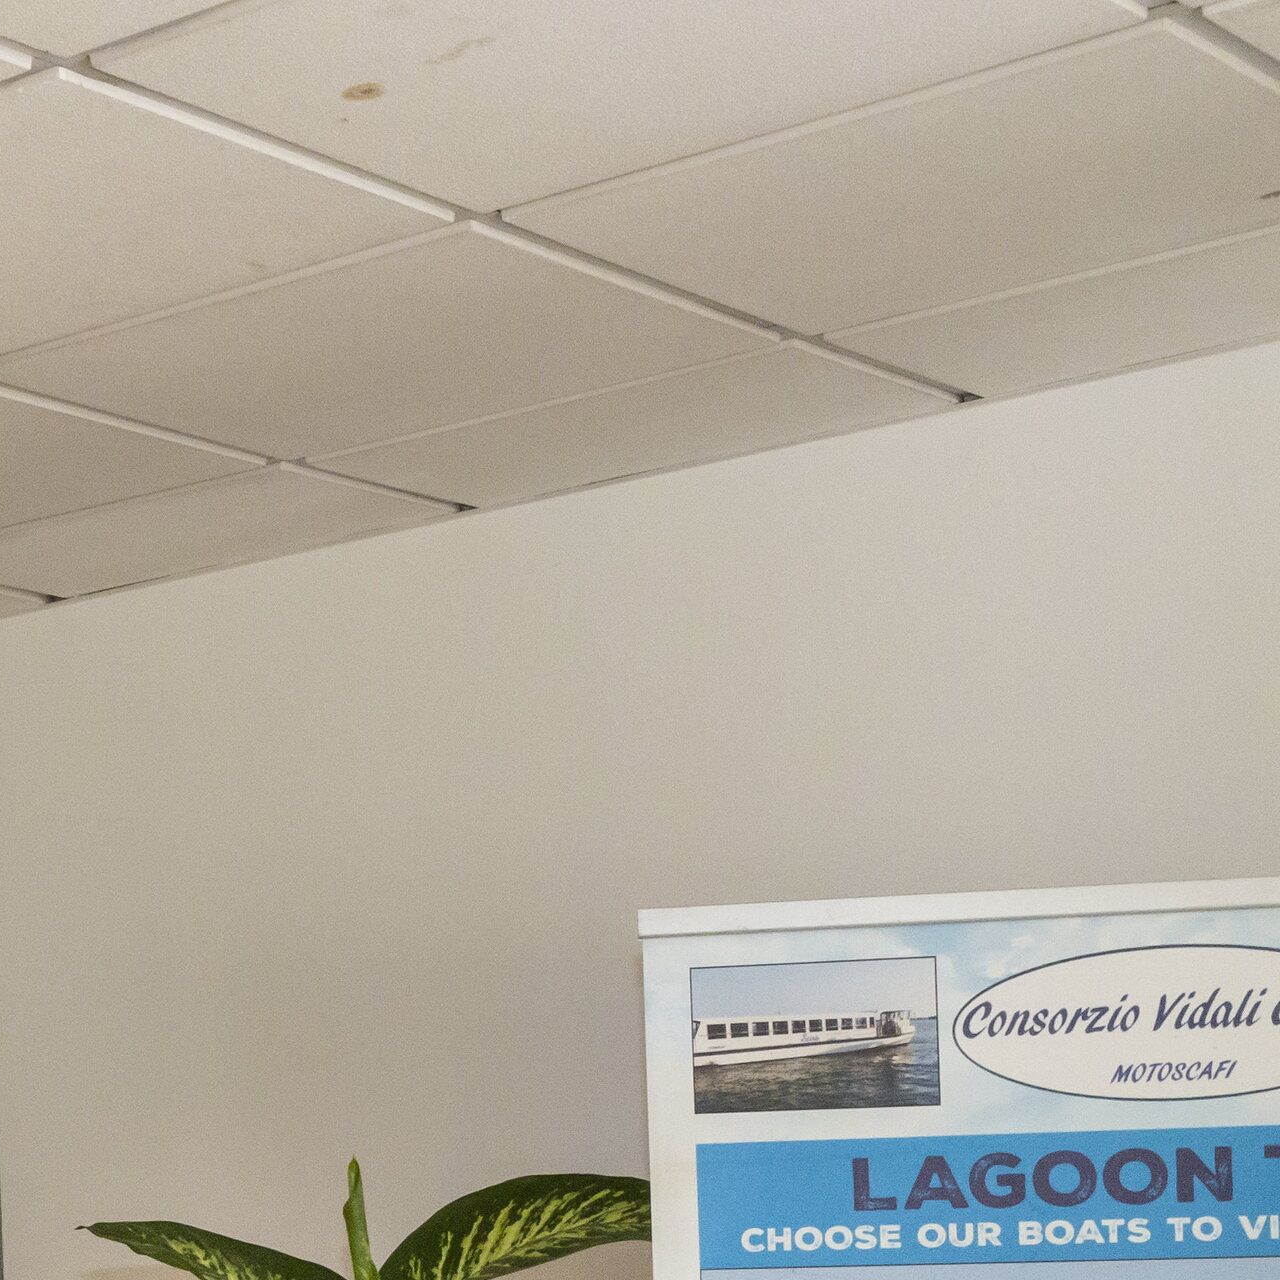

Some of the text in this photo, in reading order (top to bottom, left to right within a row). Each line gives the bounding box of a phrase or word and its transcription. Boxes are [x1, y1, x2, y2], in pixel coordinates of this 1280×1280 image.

[962, 989, 1262, 1039] Consorzio Vidali
[1110, 1059, 1238, 1083] MOTOSCAFI
[852, 1145, 1235, 1211] LAGOON
[742, 1225, 902, 1253] CHOOSE
[917, 1221, 1001, 1248] OUR
[1018, 1218, 1151, 1246] BOATS
[1167, 1217, 1222, 1243] TO
